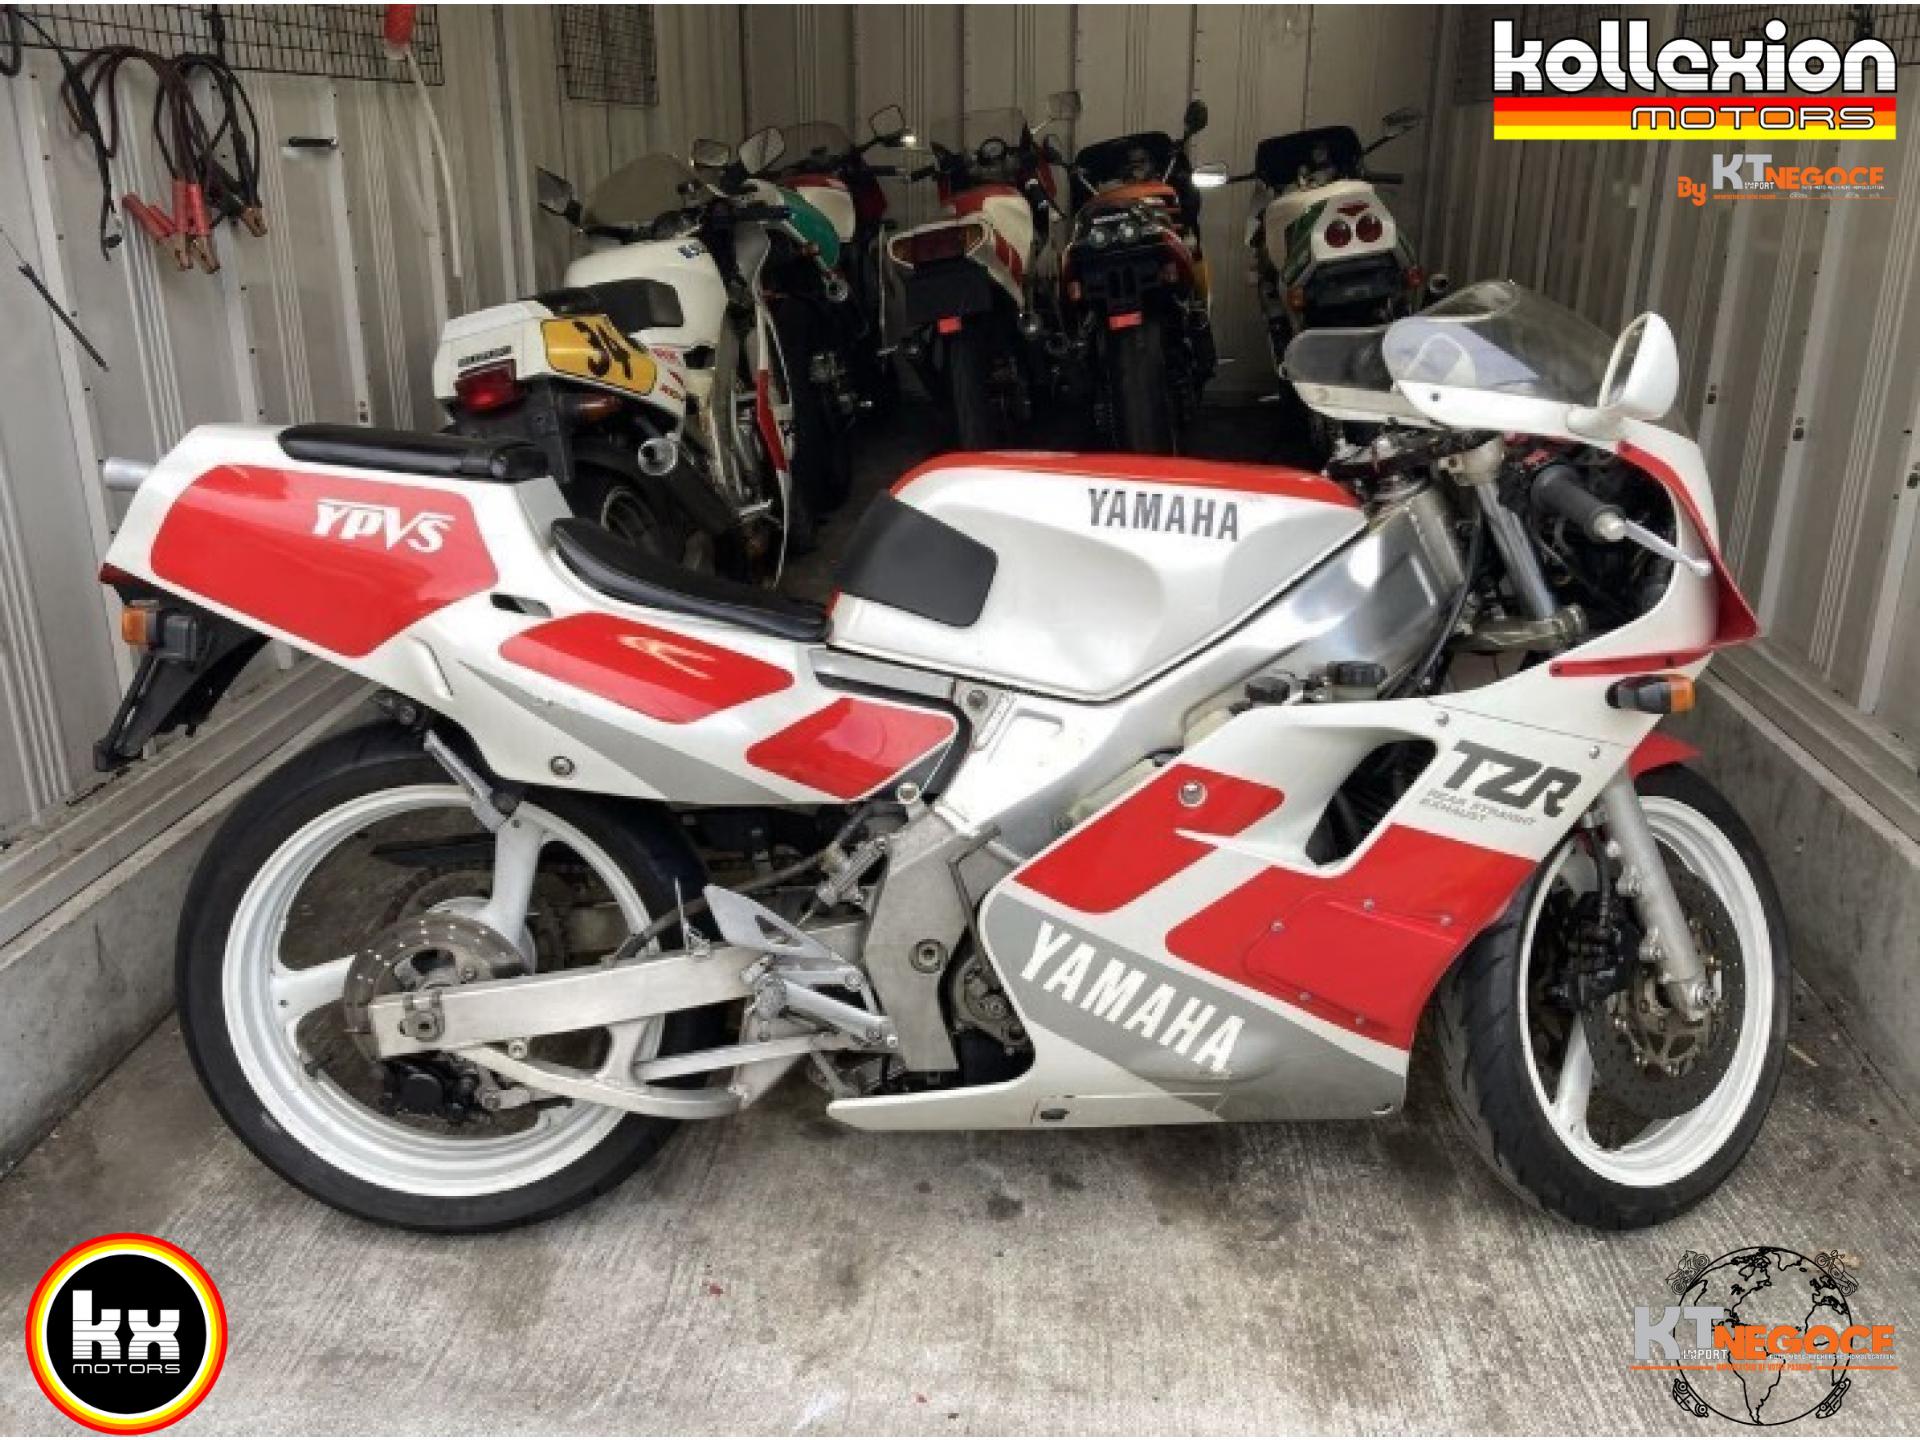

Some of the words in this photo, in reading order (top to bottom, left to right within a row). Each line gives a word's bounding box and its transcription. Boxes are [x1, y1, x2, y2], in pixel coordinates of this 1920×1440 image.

[312, 499, 456, 553] YPVS
[1088, 488, 1238, 542] YAMAHA
[1443, 740, 1582, 818] TZR
[1020, 919, 1246, 1072] YAMAHA
